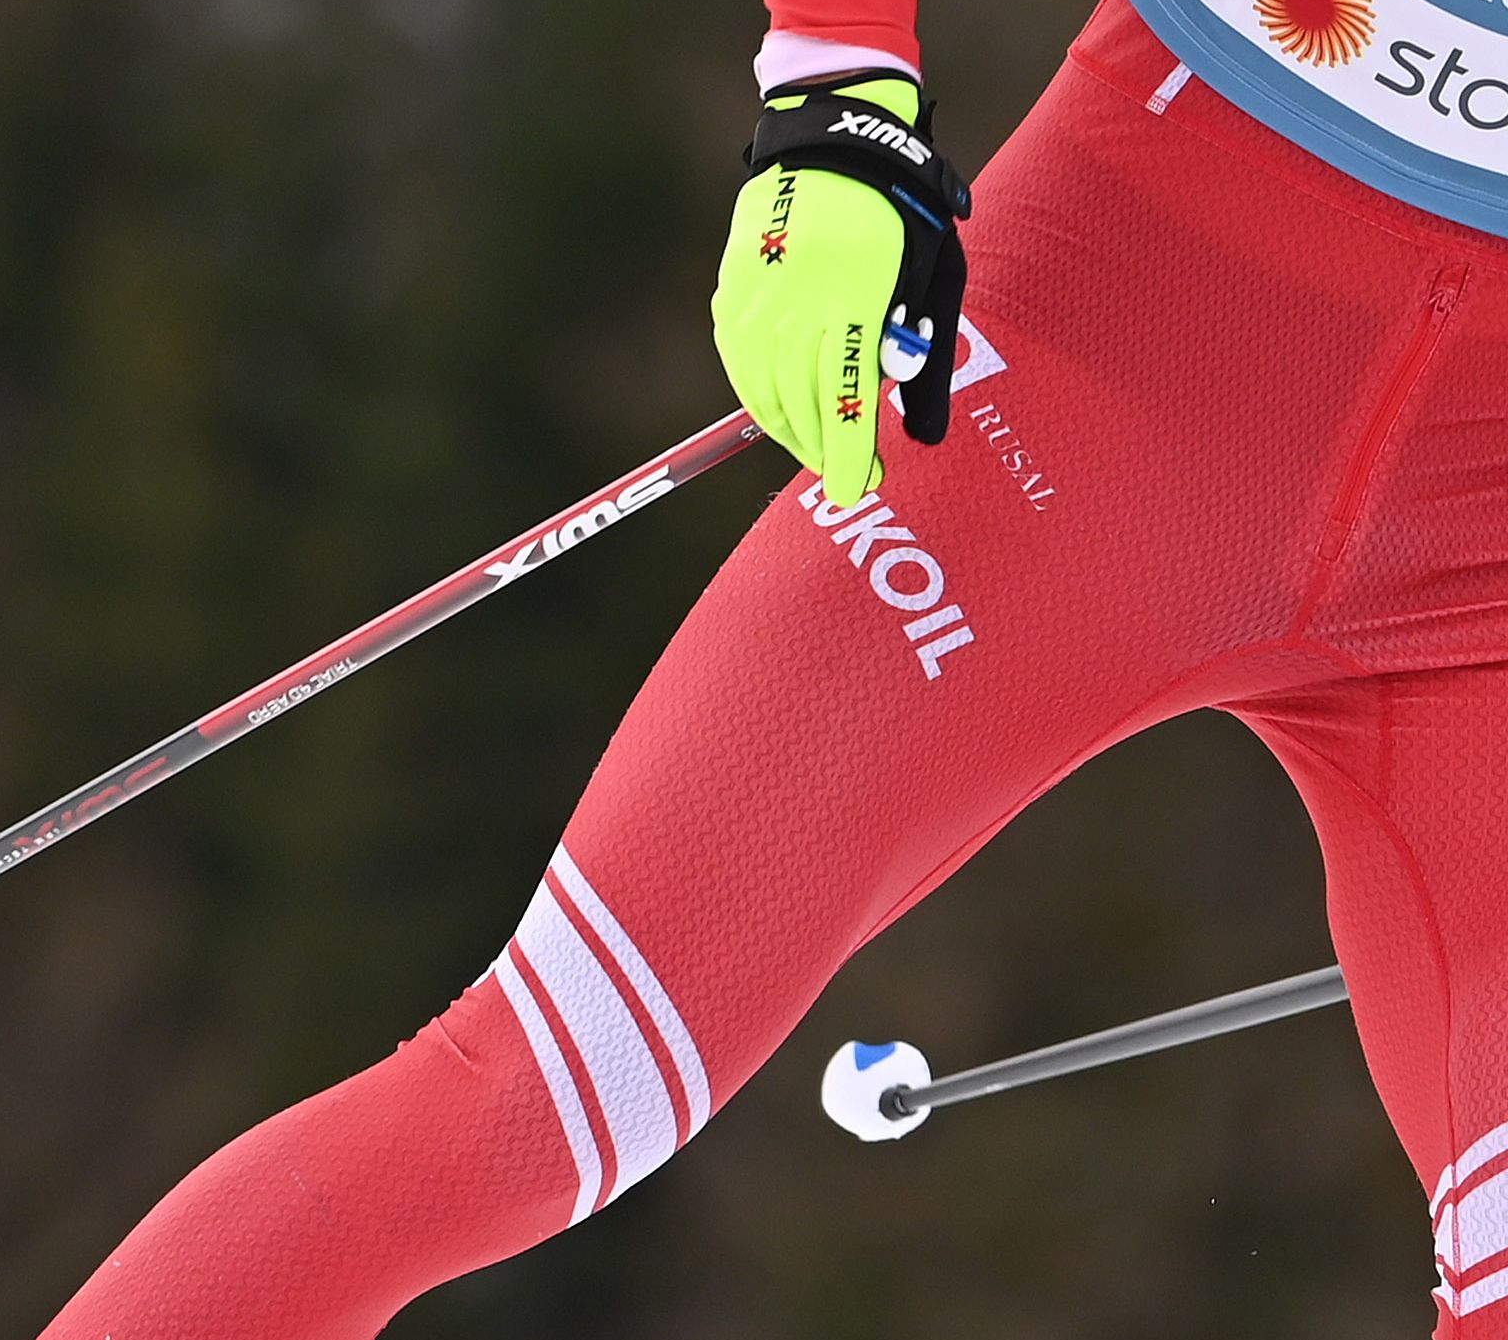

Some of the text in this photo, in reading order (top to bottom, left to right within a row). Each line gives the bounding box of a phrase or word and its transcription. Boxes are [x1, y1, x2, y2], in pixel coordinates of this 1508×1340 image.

[826, 110, 933, 166] SWIX
[970, 403, 1056, 512] RUSAL
[485, 463, 677, 589] SWIX
